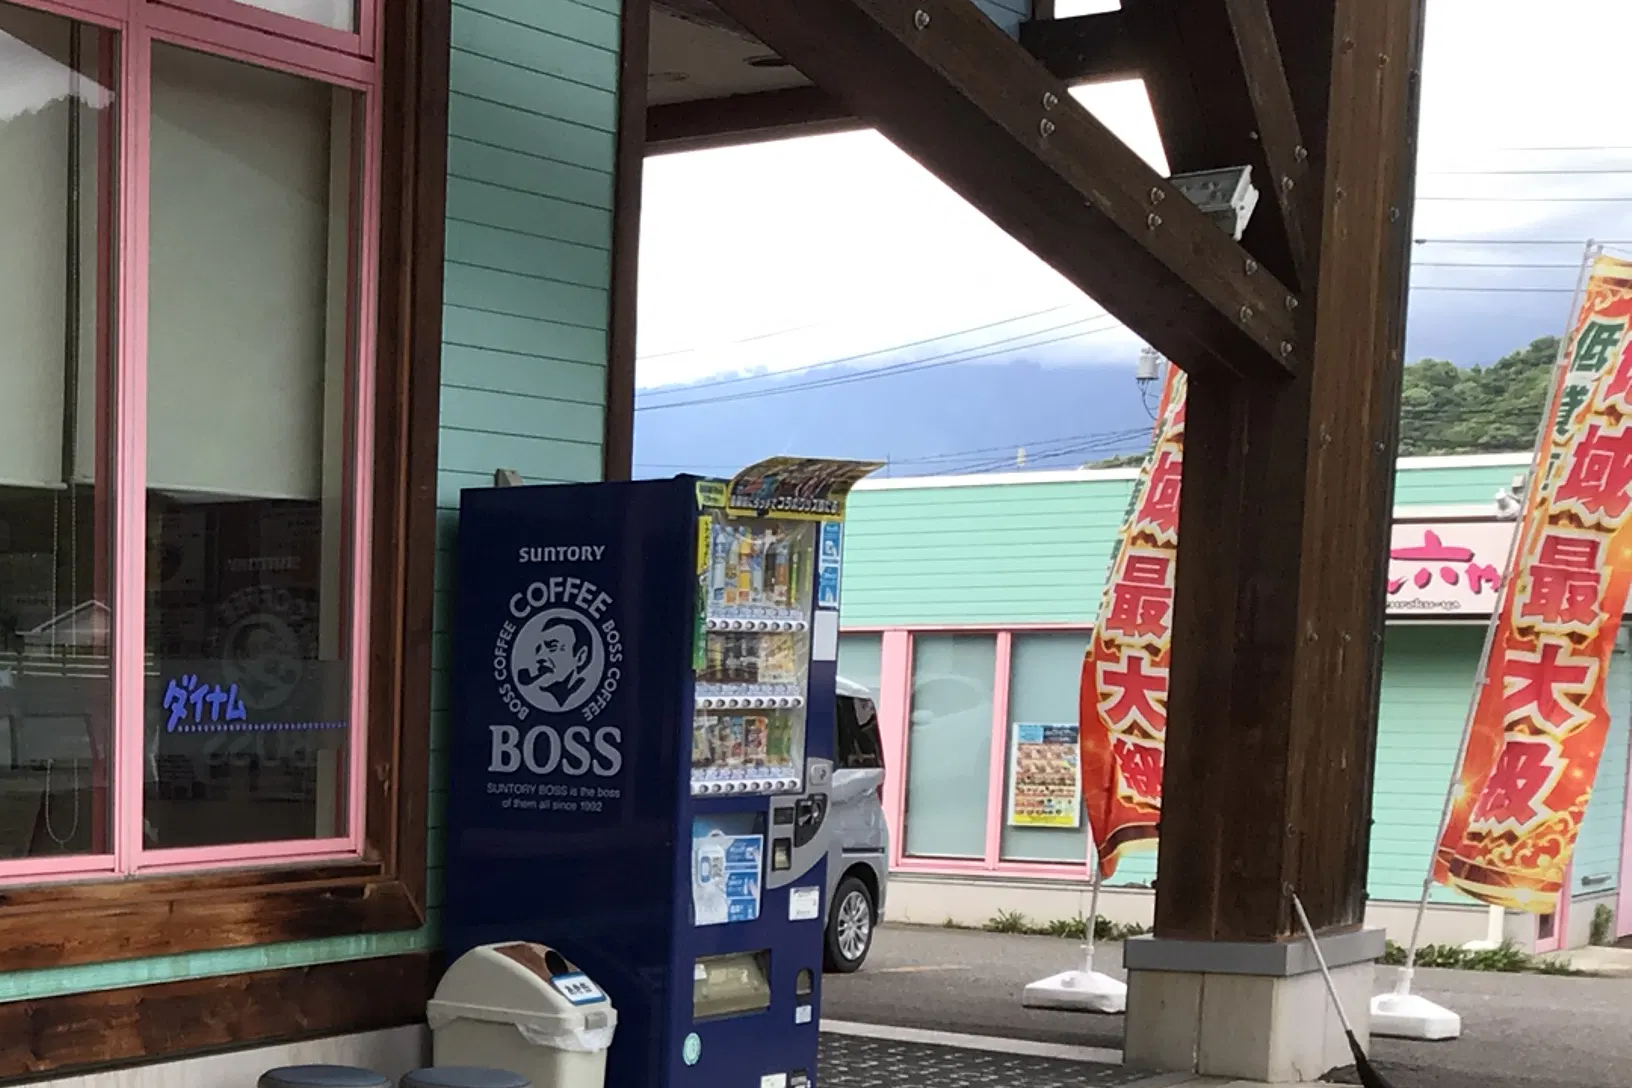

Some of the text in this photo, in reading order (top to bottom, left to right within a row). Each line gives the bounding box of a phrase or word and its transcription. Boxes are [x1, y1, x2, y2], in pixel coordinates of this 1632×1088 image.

[519, 545, 606, 562] SUNTORY
[509, 577, 614, 619] COFFEE
[494, 620, 529, 720] BOSS COFFEE
[581, 619, 623, 721] BOSS COFFEE
[162, 674, 247, 732] ダイナム
[488, 725, 622, 776] BOSS
[487, 782, 537, 794] SUNTORY
[538, 784, 568, 796] BOSS
